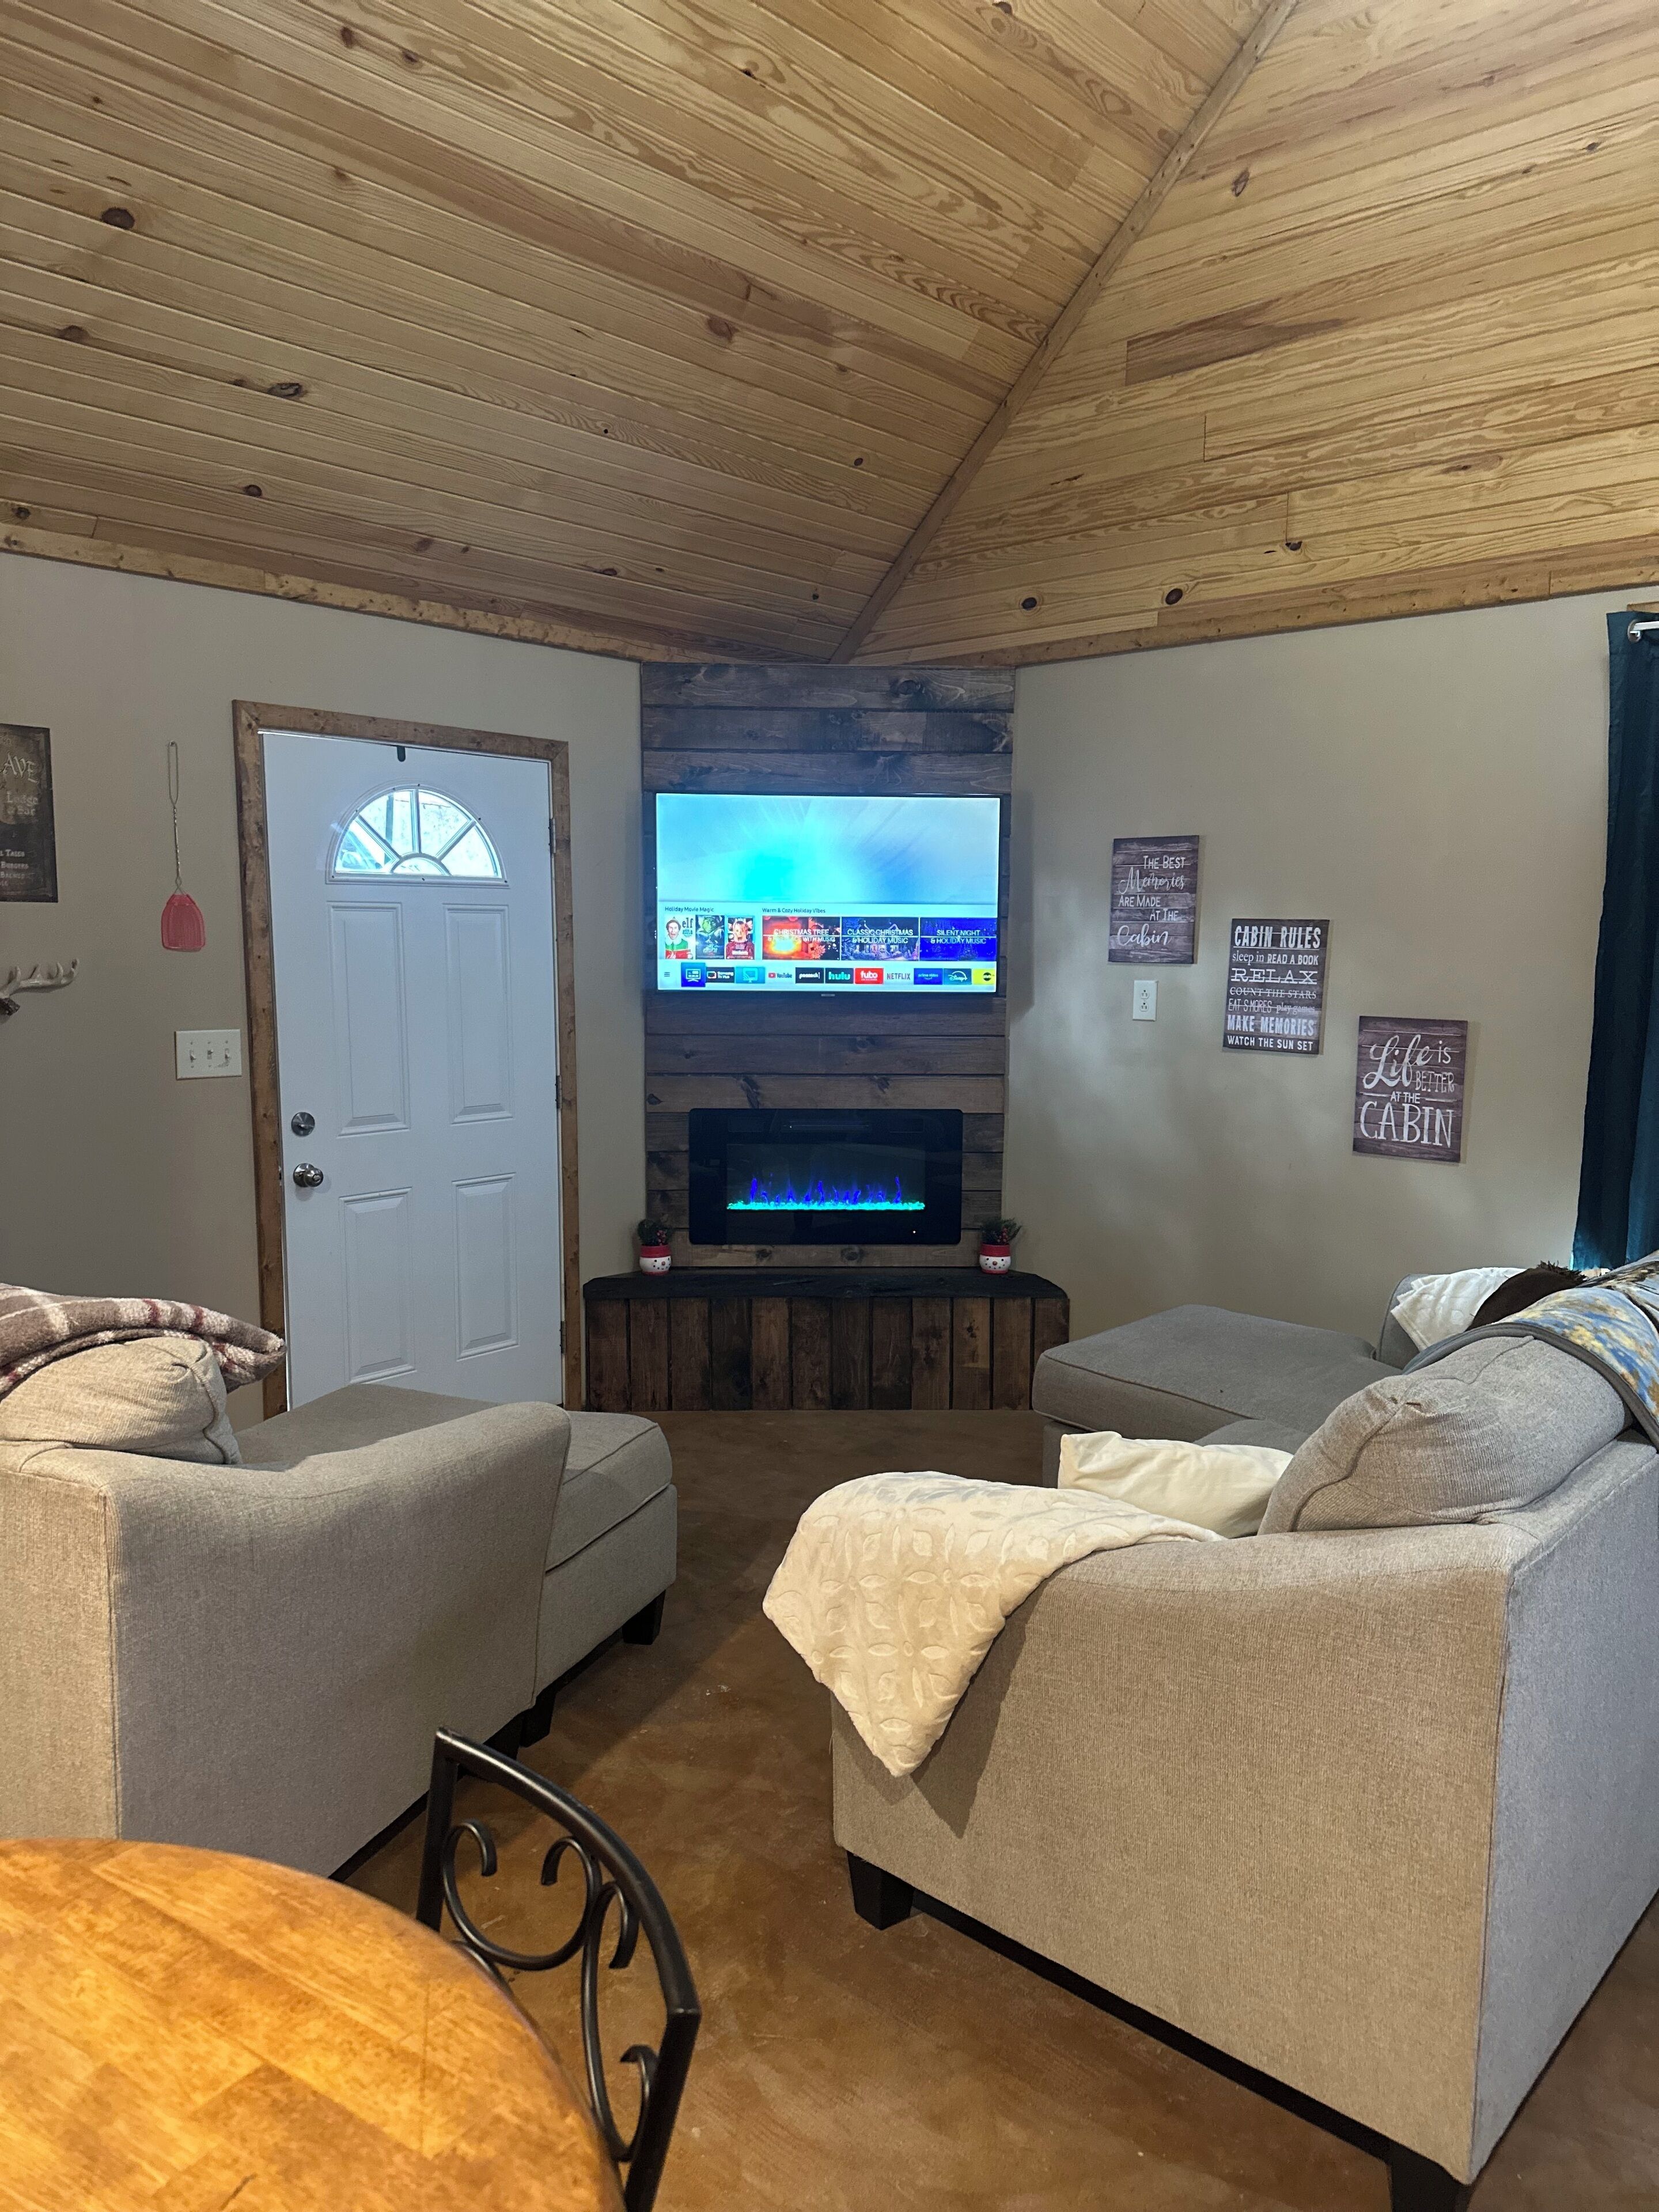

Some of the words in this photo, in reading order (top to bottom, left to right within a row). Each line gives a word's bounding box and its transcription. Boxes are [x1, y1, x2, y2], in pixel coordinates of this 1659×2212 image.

[1143, 855, 1160, 870] THE
[1162, 855, 1185, 869] BEST
[1118, 866, 1185, 895] Memories
[1118, 895, 1135, 908] ARE
[1137, 895, 1161, 908] MADE
[682, 916, 694, 928] elf
[1150, 908, 1160, 922] AT
[1163, 908, 1179, 922] THE
[1117, 923, 1171, 948] Cabin
[1234, 925, 1273, 948] CABIN
[1279, 926, 1321, 949] RULES
[1232, 950, 1254, 966] sleep
[1256, 951, 1264, 962] in
[1267, 953, 1287, 964] READ
[1289, 955, 1296, 965] A
[1298, 955, 1319, 965] BOOK
[828, 971, 850, 980] hulu
[860, 970, 878, 979] fubo
[1230, 968, 1318, 985] RELAX
[1229, 986, 1264, 997] COUNT
[1266, 987, 1286, 998] THE
[1287, 989, 1317, 999] STARS
[1228, 998, 1241, 1012] EAT
[1275, 1001, 1291, 1014] play
[1292, 1004, 1316, 1016] games
[1227, 1014, 1255, 1032] MAKE
[1260, 1016, 1315, 1036] MEMORIES
[1227, 1035, 1255, 1046] WATCH
[1258, 1037, 1274, 1048] THE
[1277, 1039, 1294, 1050] SUN
[1297, 1040, 1313, 1051] SET
[1363, 1033, 1434, 1089] Life
[1438, 1040, 1452, 1064] is
[1415, 1070, 1455, 1093] BETTER
[1390, 1091, 1401, 1103] AT
[1403, 1092, 1421, 1104] THE
[1360, 1101, 1455, 1148] CABIN
